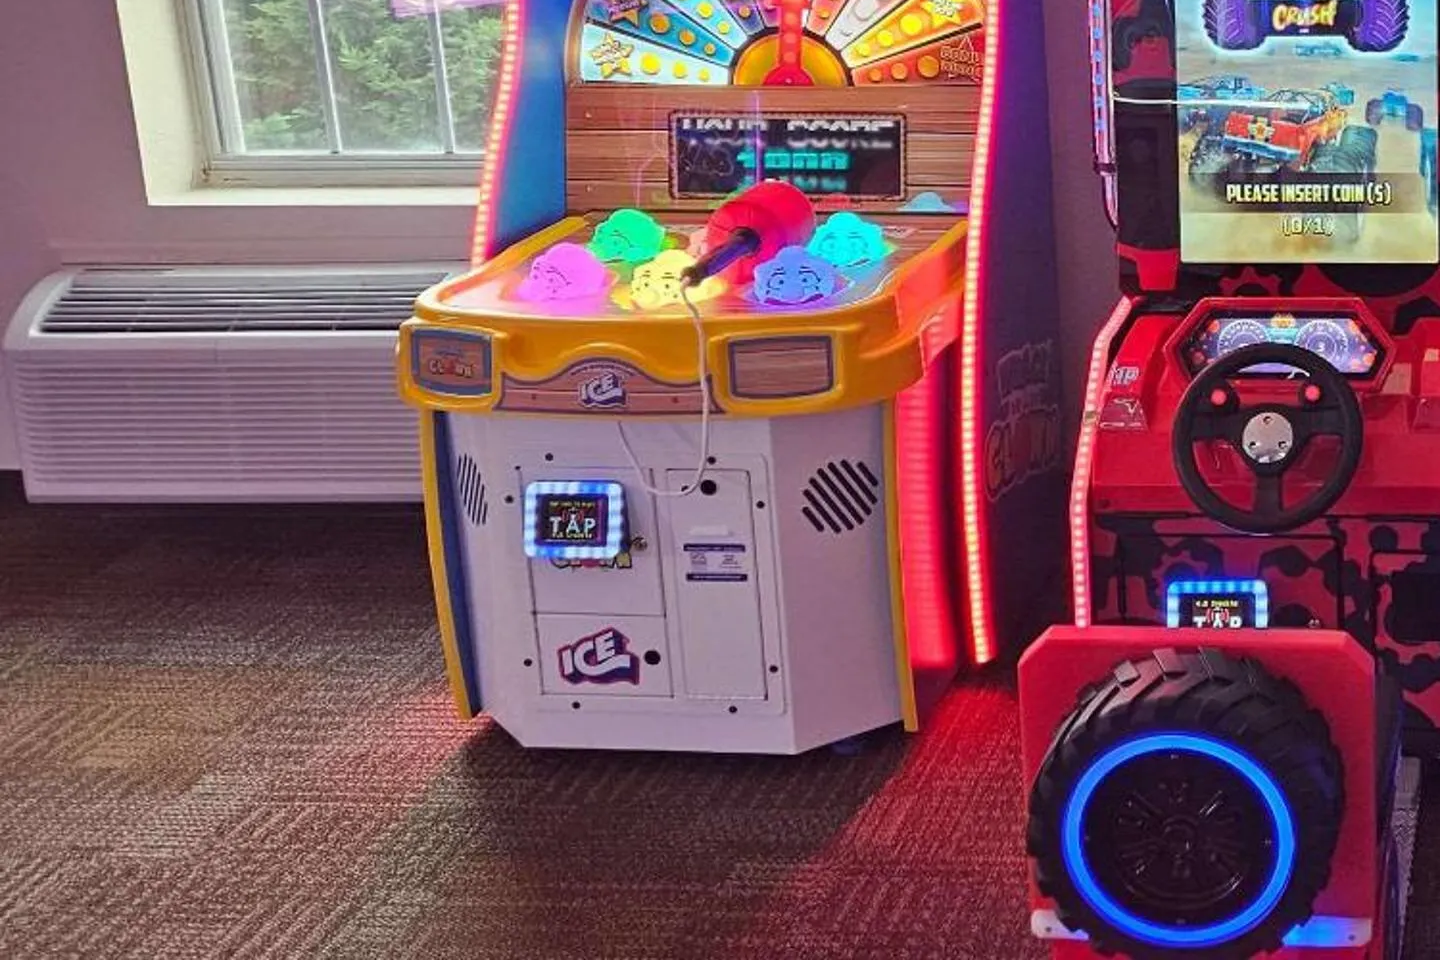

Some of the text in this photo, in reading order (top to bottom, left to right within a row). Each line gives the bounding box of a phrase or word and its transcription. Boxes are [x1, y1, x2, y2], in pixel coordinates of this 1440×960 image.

[1273, 0, 1338, 30] CRUSH
[1226, 183, 1277, 204] PLEASE
[1281, 183, 1330, 204] INSERT
[580, 372, 628, 408] ICE
[549, 514, 597, 536] TAP
[559, 628, 639, 685] ICE
